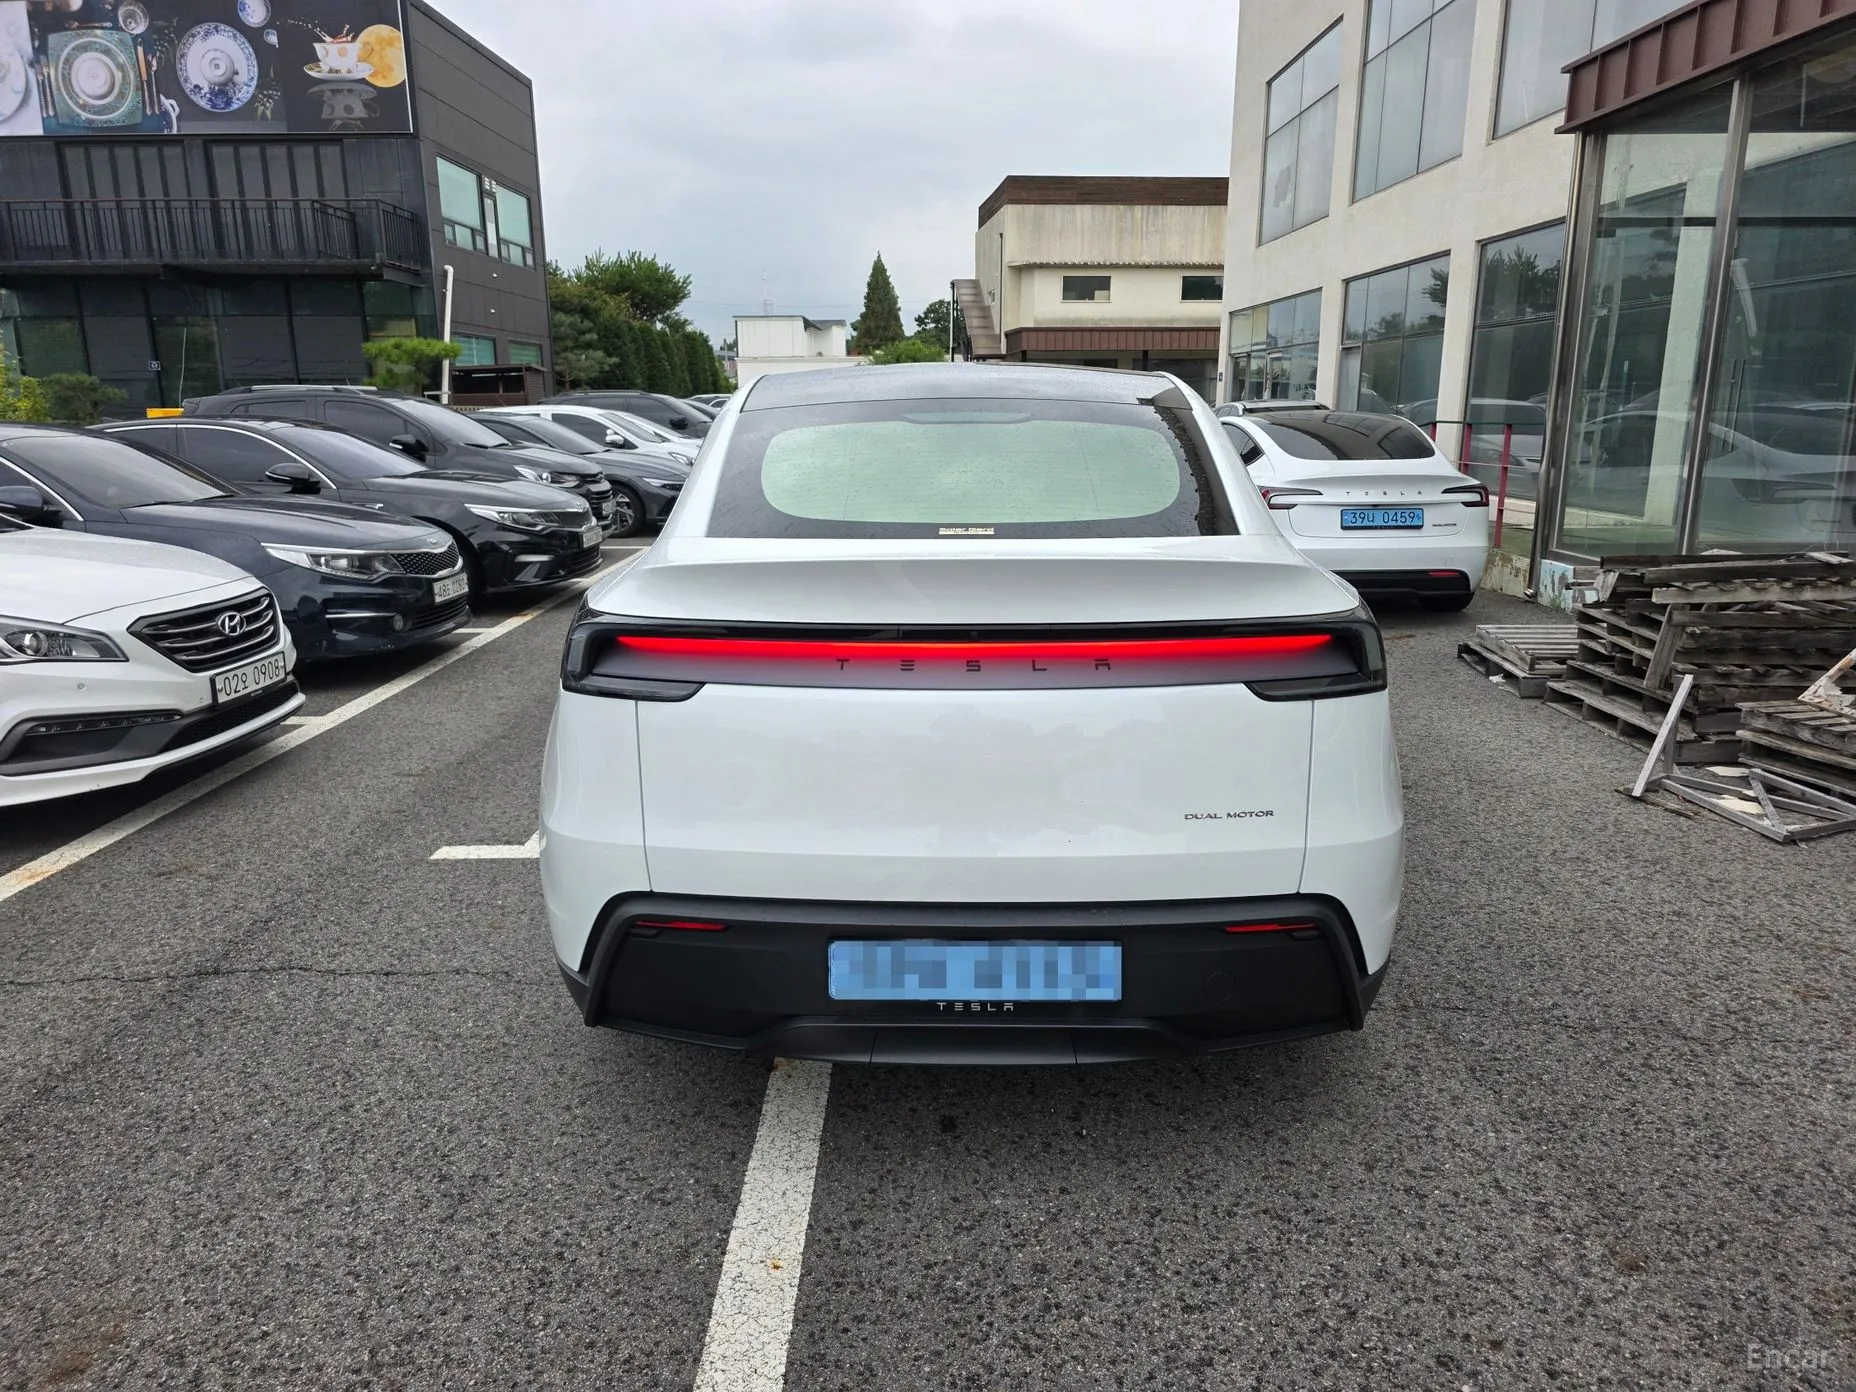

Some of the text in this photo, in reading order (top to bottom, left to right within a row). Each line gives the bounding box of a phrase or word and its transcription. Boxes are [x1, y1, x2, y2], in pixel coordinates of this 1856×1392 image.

[1382, 511, 1416, 524] 0459
[836, 658, 1111, 672] TESLA
[223, 658, 280, 697] 02오 0908
[1226, 810, 1274, 819] MOTOR
[936, 1002, 1014, 1012] TESLA
